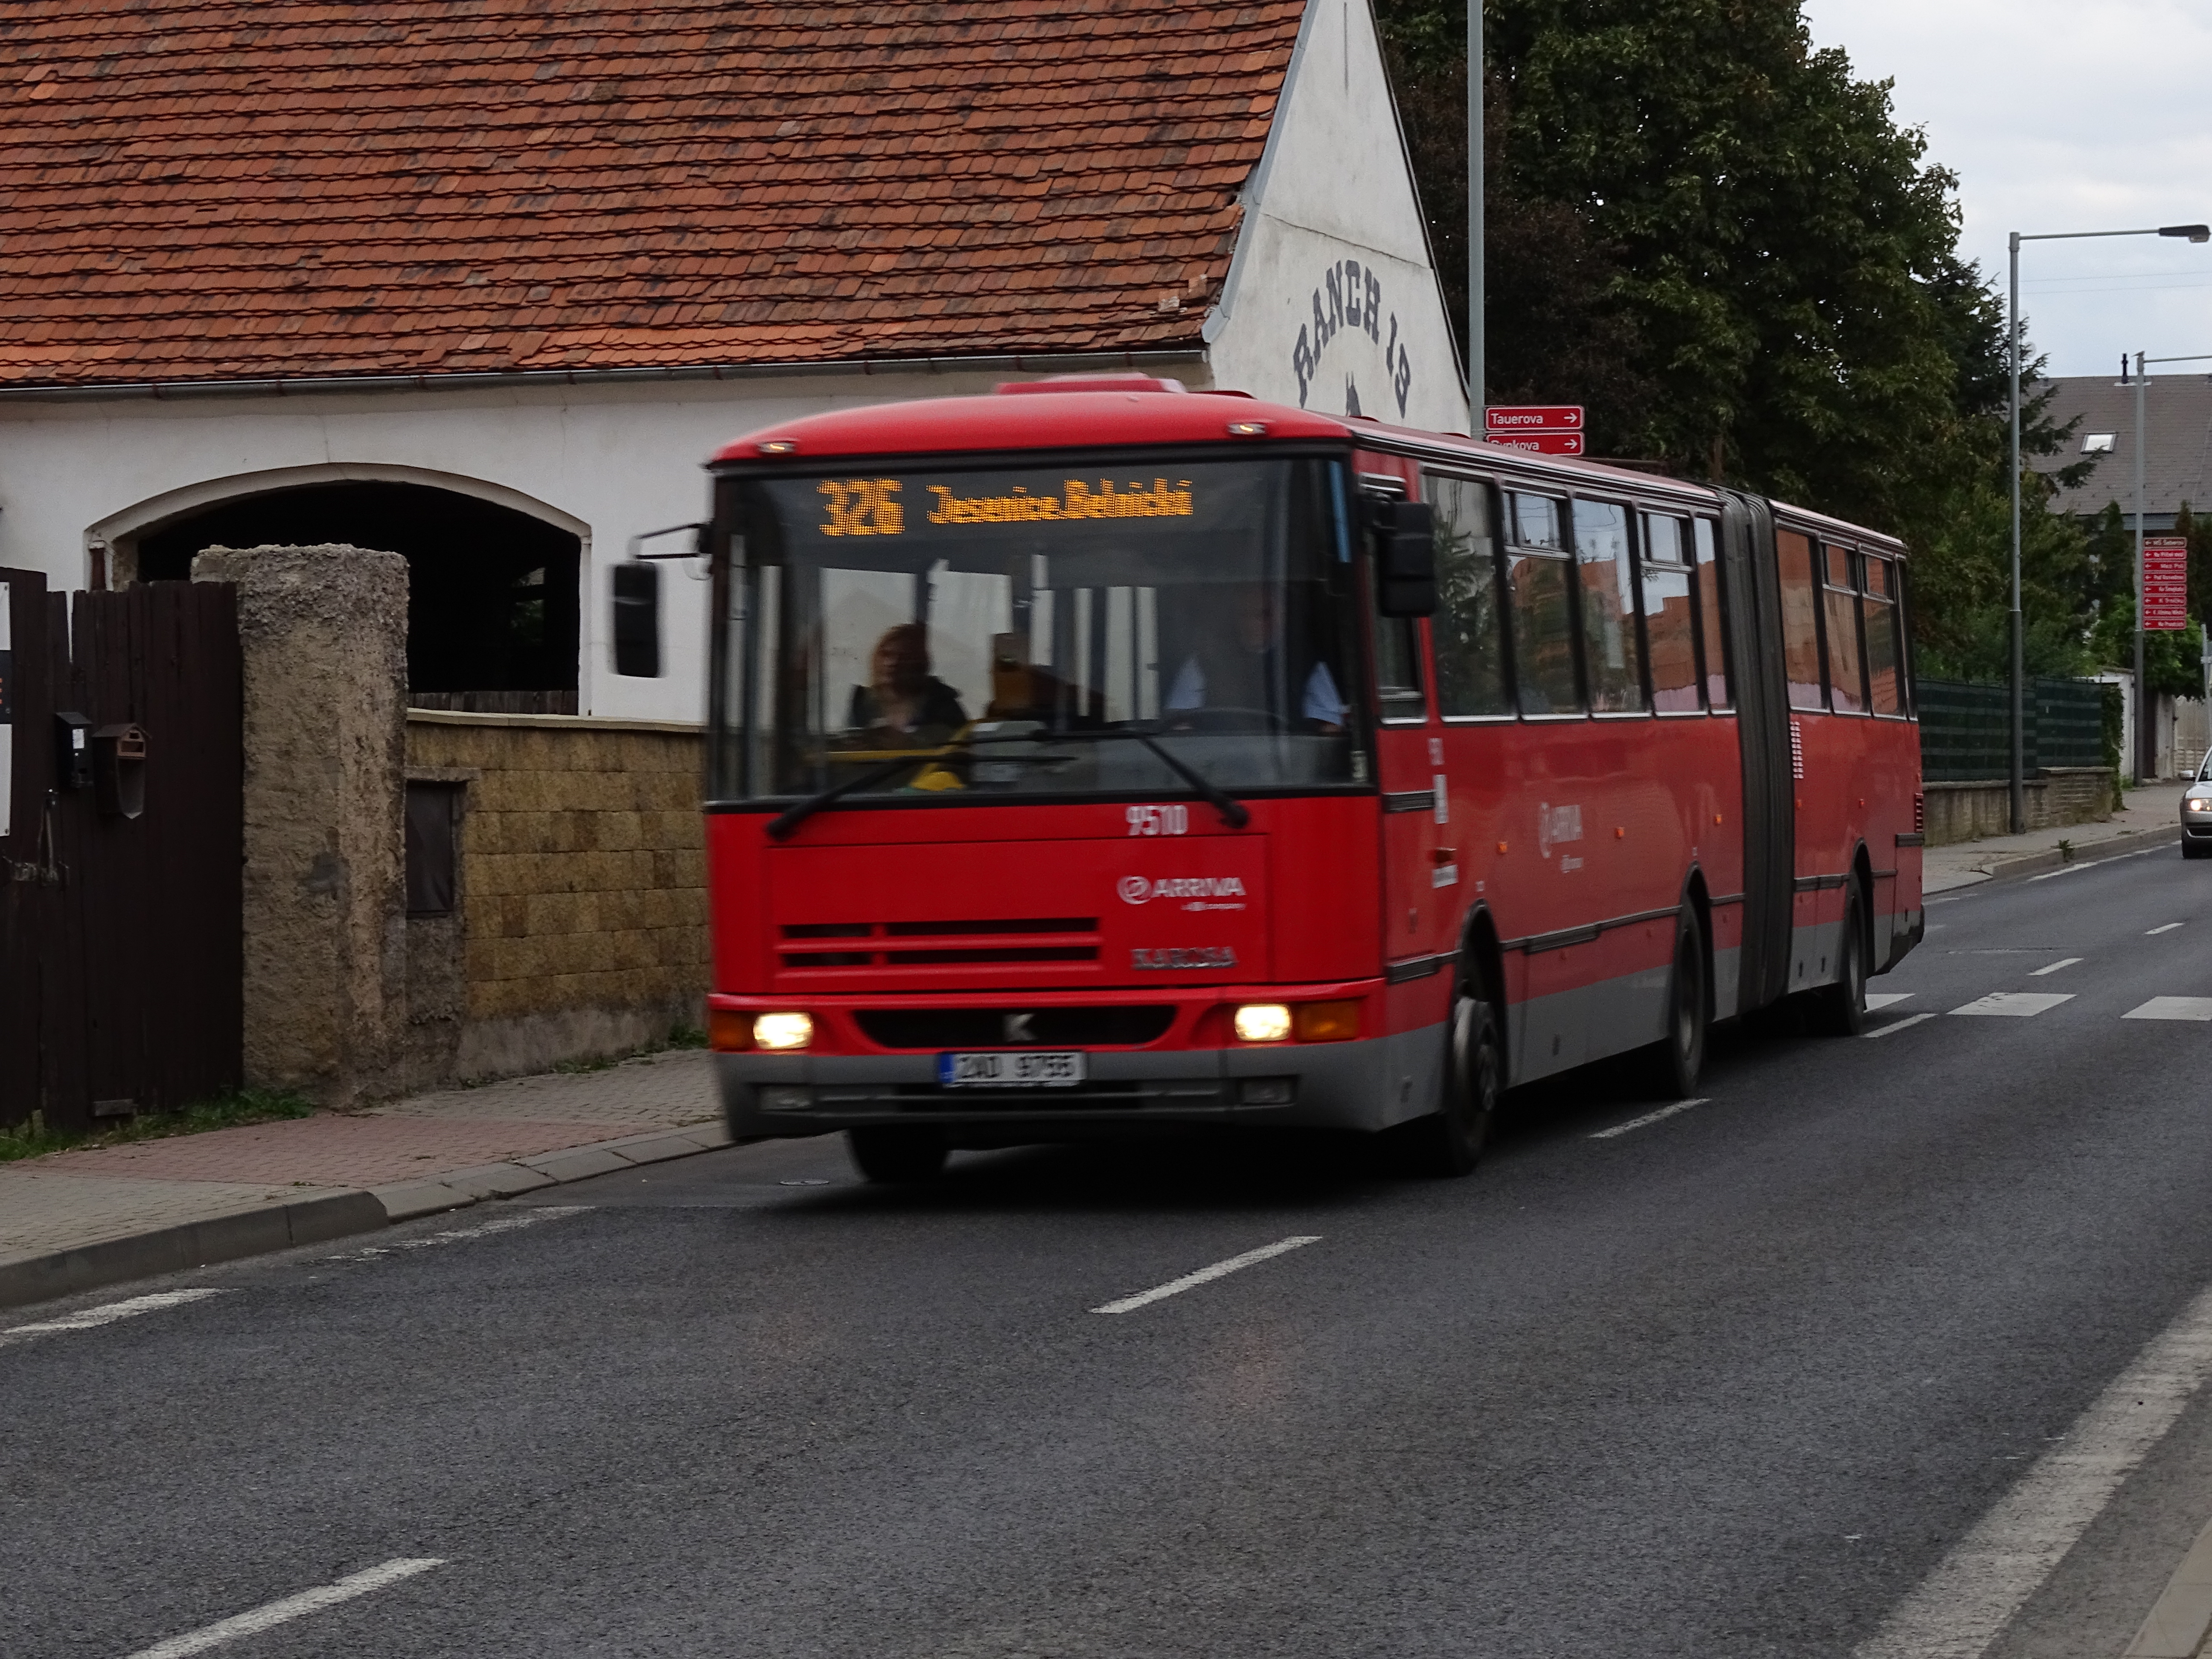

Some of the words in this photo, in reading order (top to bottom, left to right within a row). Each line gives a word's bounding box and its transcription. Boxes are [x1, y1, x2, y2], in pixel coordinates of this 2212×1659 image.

[1293, 259, 1380, 409] RANCH
[1490, 413, 1543, 425] Tauerova
[817, 478, 905, 536] 326
[1126, 805, 1188, 835] 9510
[1151, 877, 1247, 898] ARRIVA
